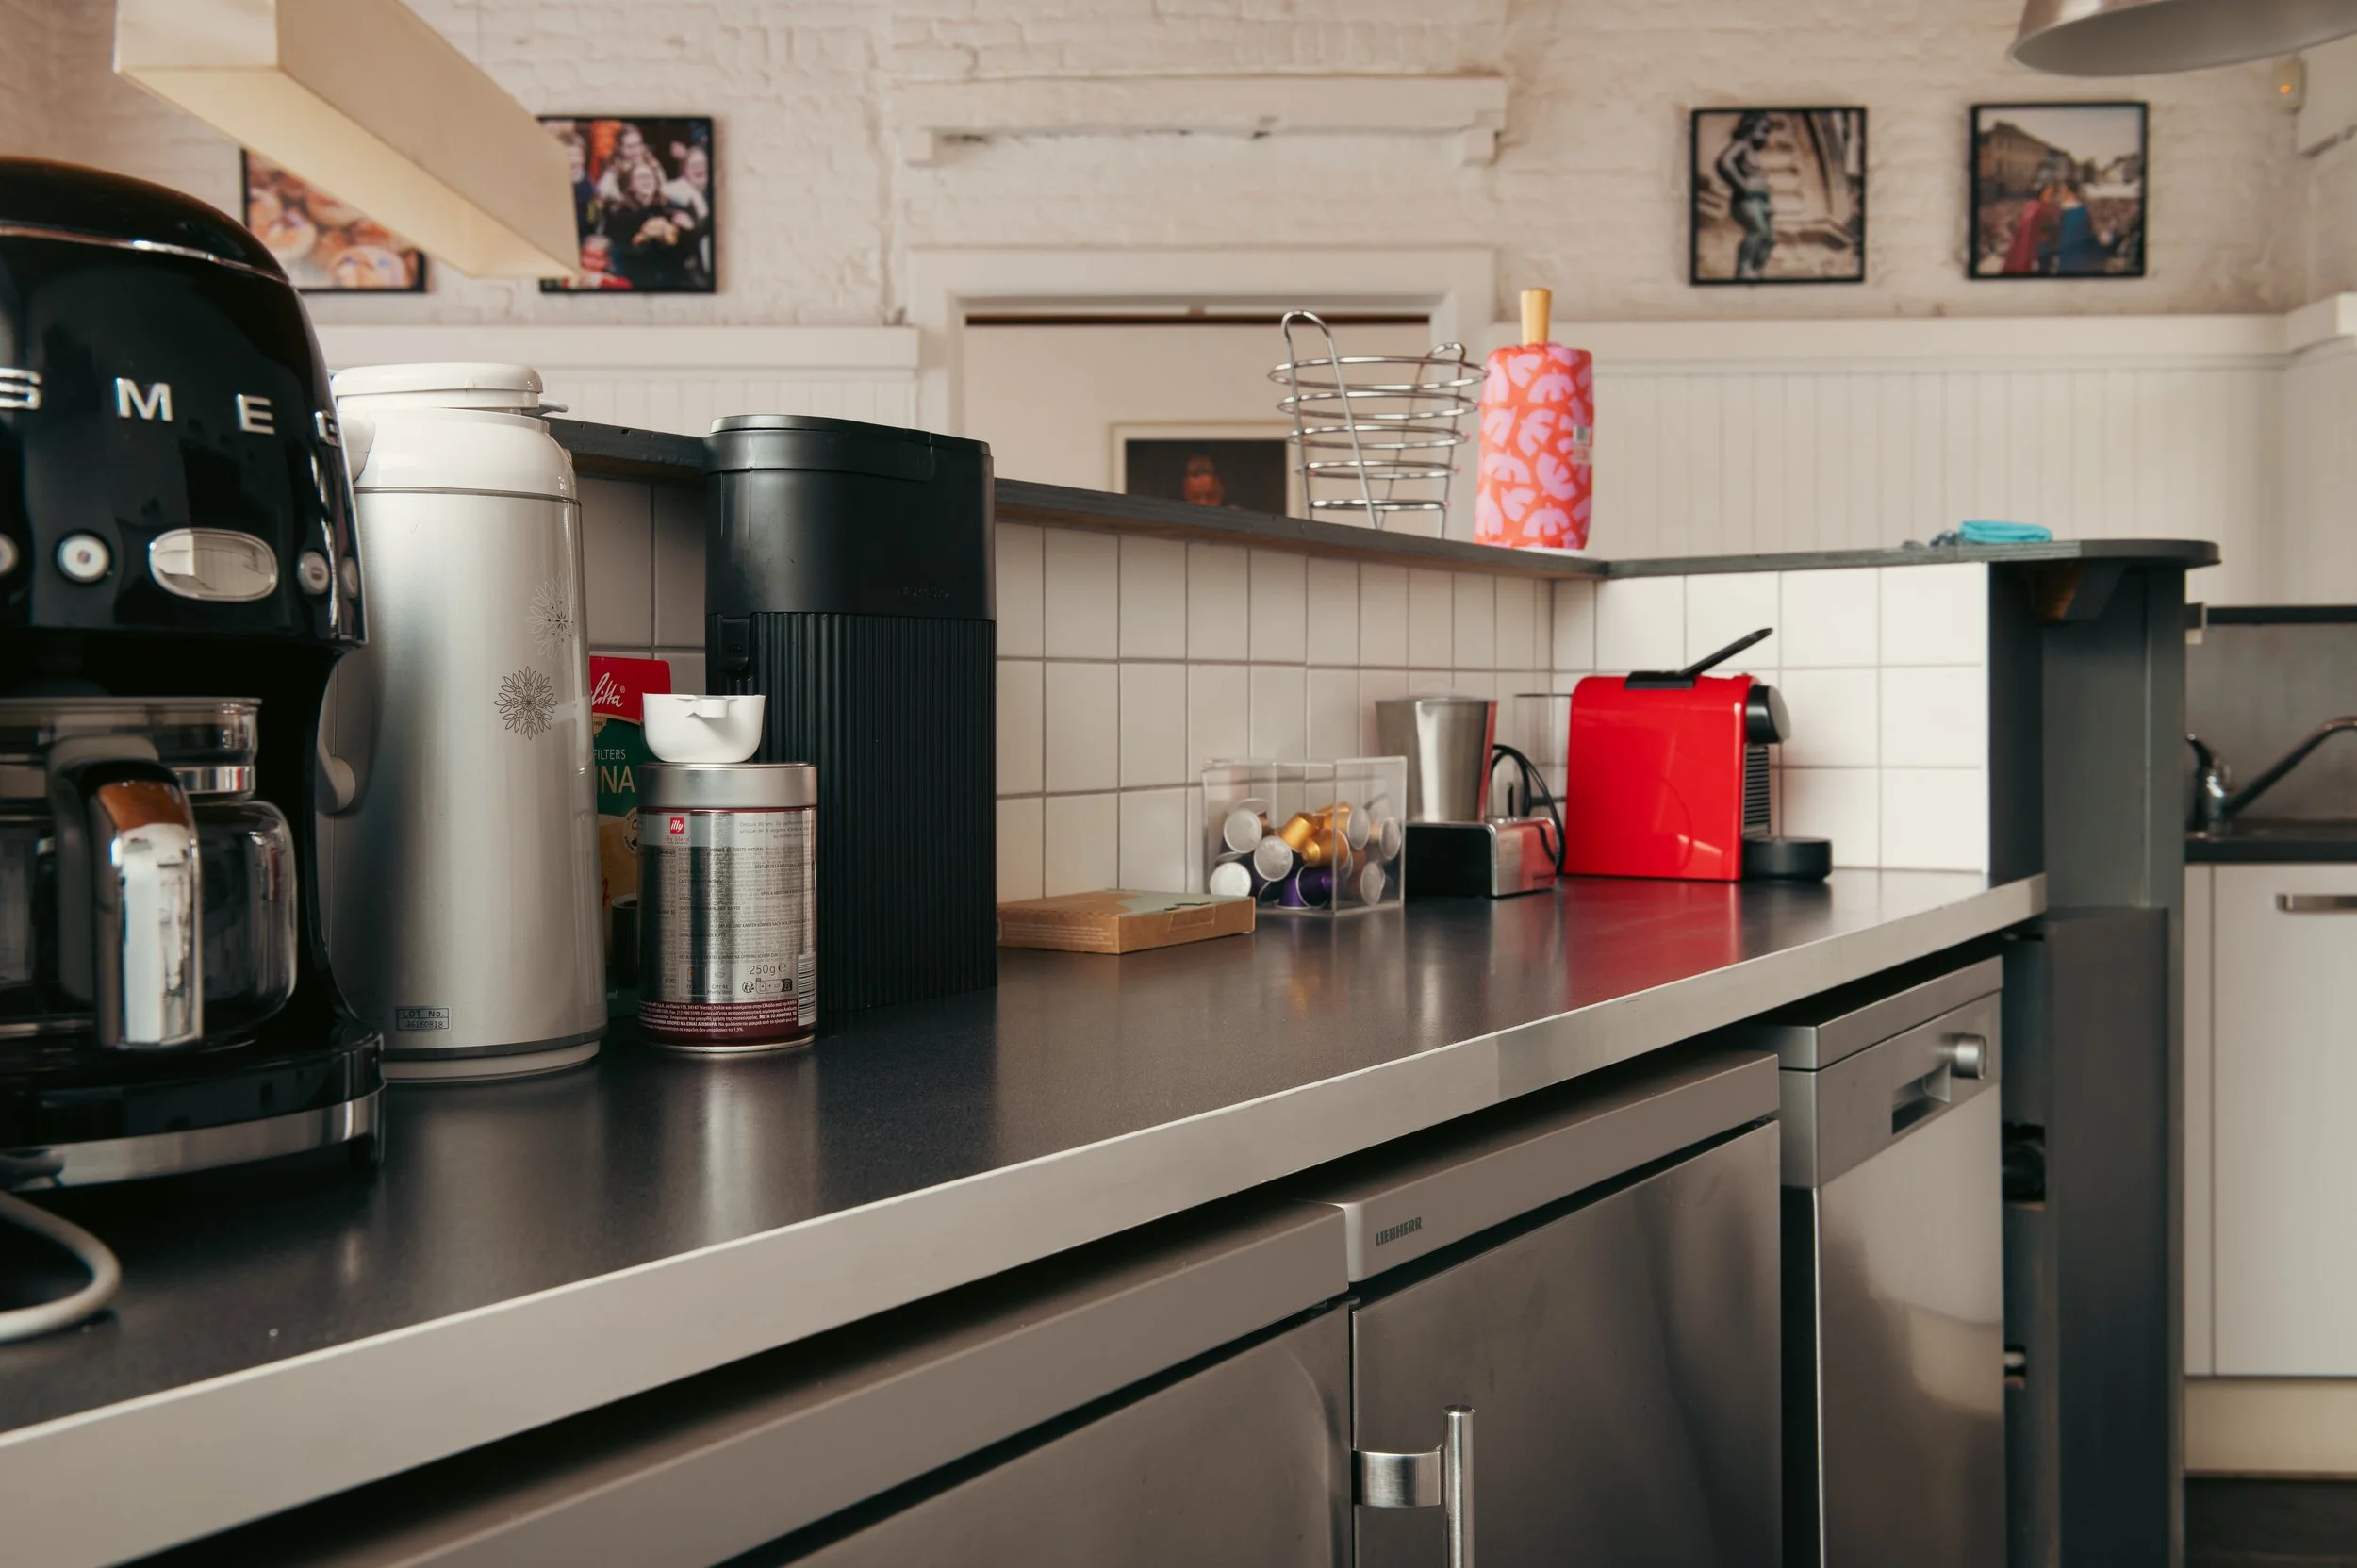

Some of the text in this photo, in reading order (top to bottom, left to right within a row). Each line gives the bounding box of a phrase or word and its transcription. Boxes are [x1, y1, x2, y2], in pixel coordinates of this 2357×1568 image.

[670, 818, 684, 833] illy
[750, 965, 776, 976] 250g
[1376, 1216, 1422, 1246] LIEBHERR
